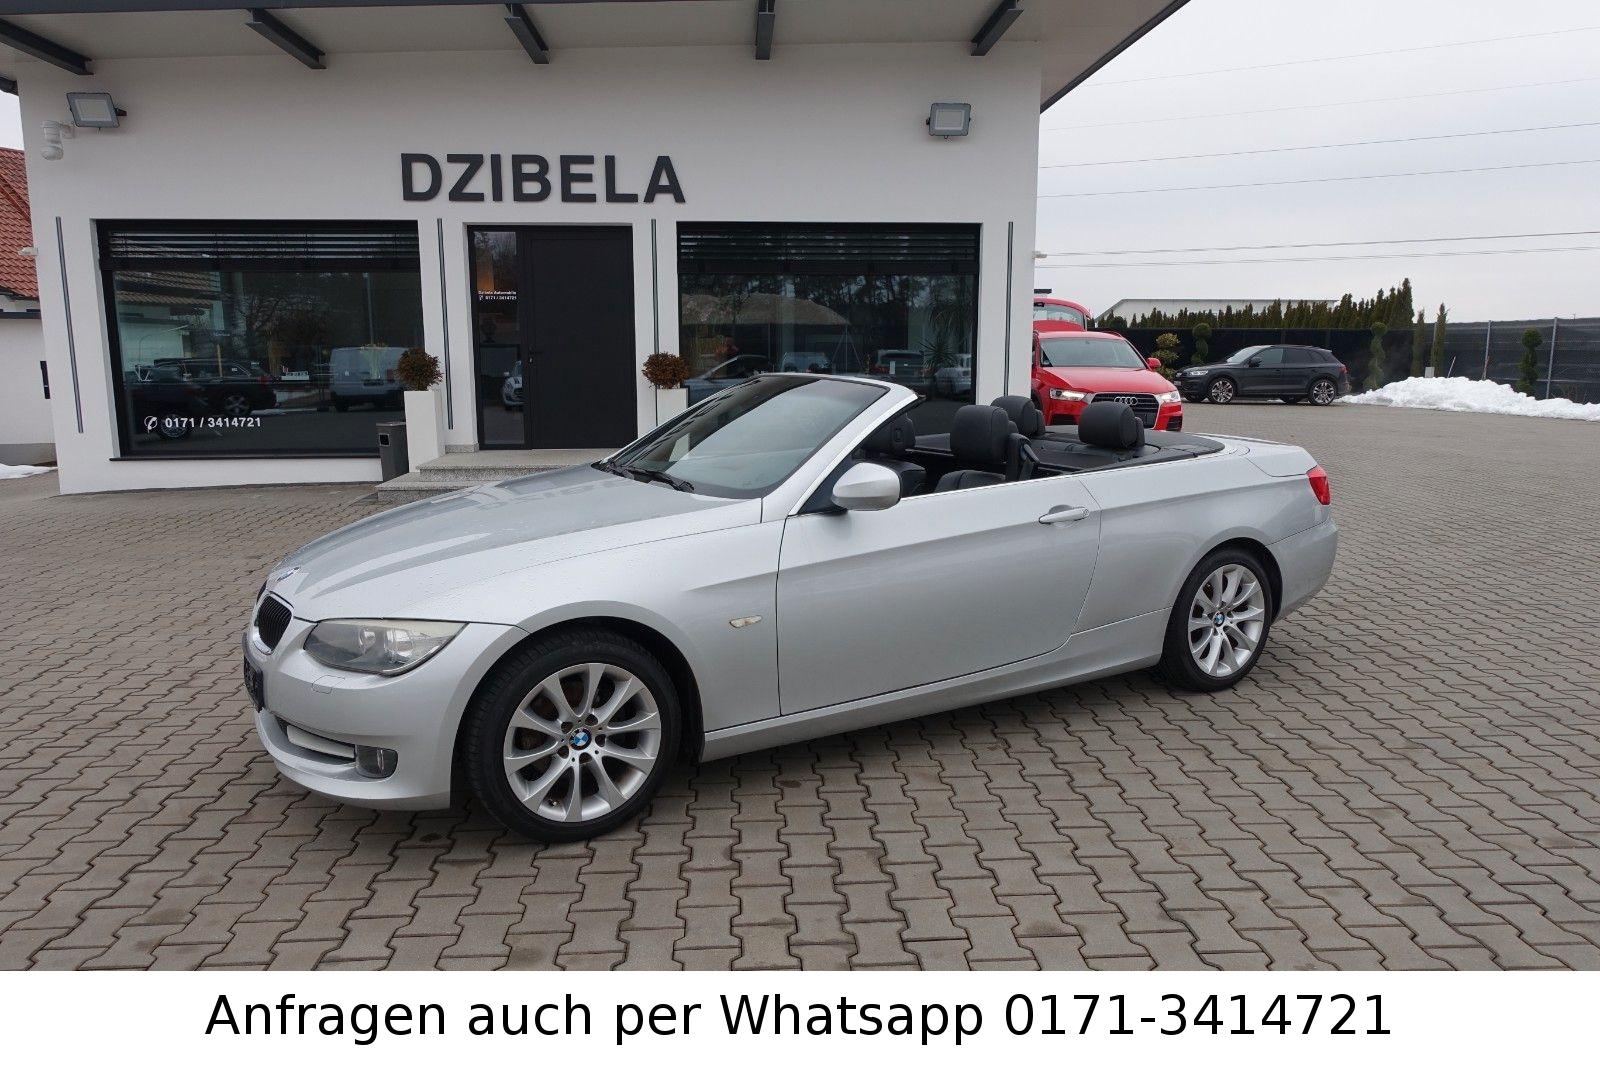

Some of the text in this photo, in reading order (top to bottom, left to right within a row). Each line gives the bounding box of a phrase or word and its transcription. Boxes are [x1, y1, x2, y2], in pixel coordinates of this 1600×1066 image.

[401, 153, 686, 203] DZIBELA
[165, 417, 195, 428] 0171
[207, 417, 261, 428] 3414721
